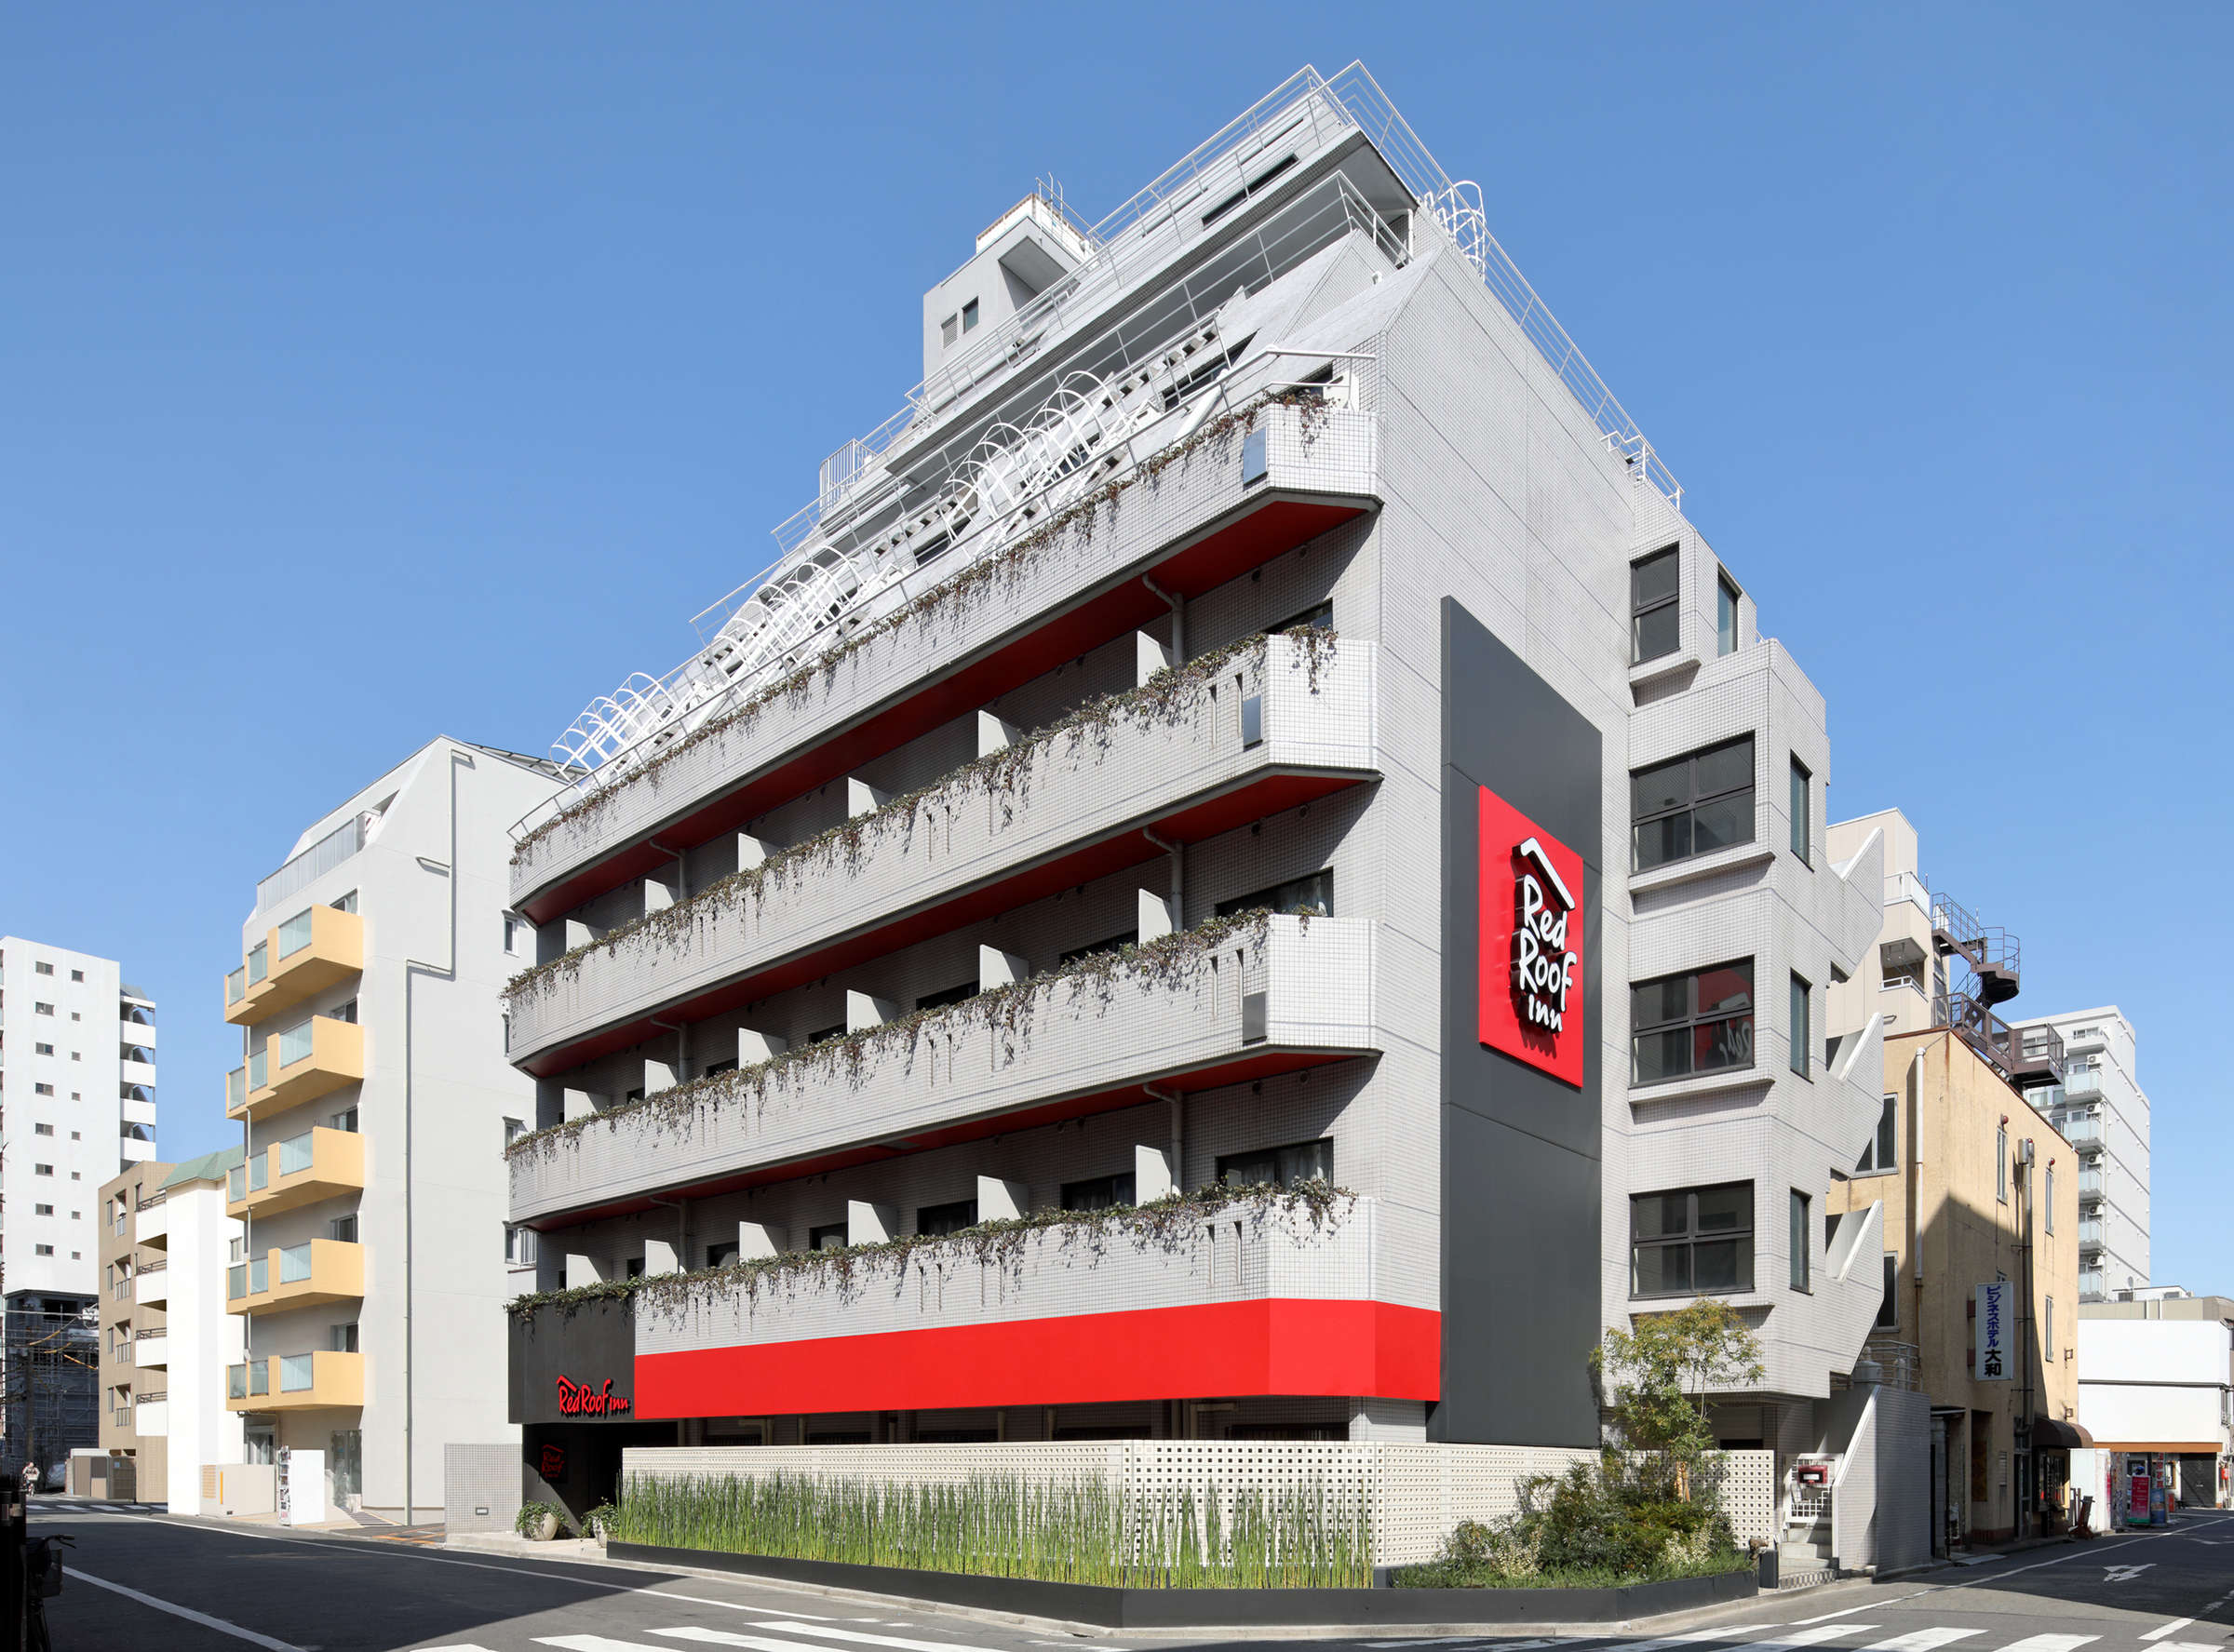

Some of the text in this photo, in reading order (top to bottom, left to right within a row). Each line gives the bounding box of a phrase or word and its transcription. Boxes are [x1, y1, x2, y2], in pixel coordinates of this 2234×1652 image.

[1523, 873, 1568, 950] Red
[1519, 927, 1577, 1012] Roof
[558, 1385, 581, 1414] Red
[581, 1378, 611, 1414] Roof
